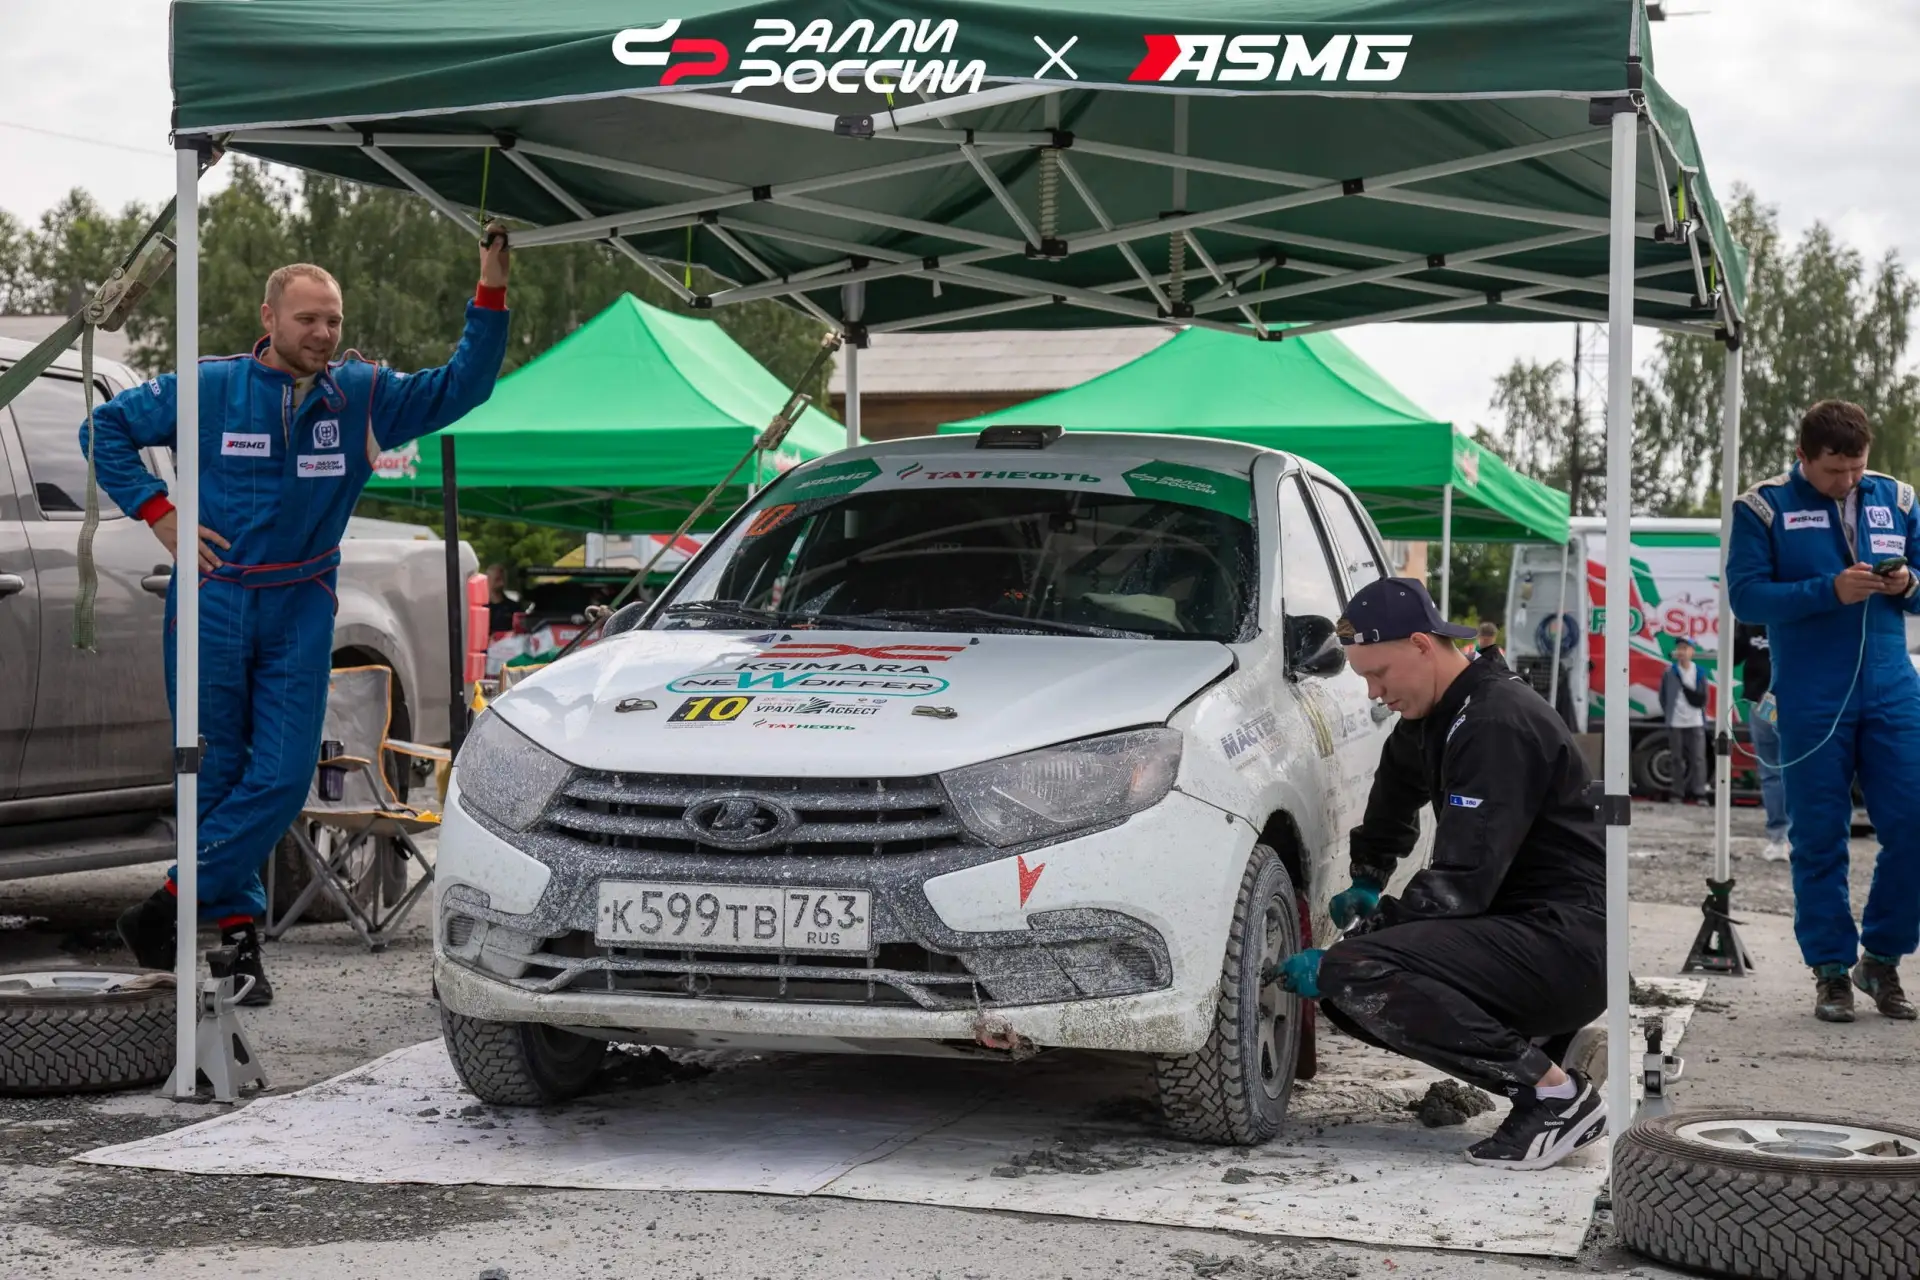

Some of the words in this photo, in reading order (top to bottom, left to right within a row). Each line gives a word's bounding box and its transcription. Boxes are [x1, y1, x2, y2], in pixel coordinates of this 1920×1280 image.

[232, 440, 266, 450] ASMG
[924, 470, 1102, 483] ТАТНЕФТЬ
[735, 662, 930, 674] KSIMARA
[683, 697, 749, 721] 10
[753, 705, 795, 713] УРАЛ
[825, 706, 881, 716] АСБЕСТ
[767, 723, 856, 731] ТАТНЕФТЬ
[790, 894, 857, 930] 763
[806, 931, 841, 946] RUS
